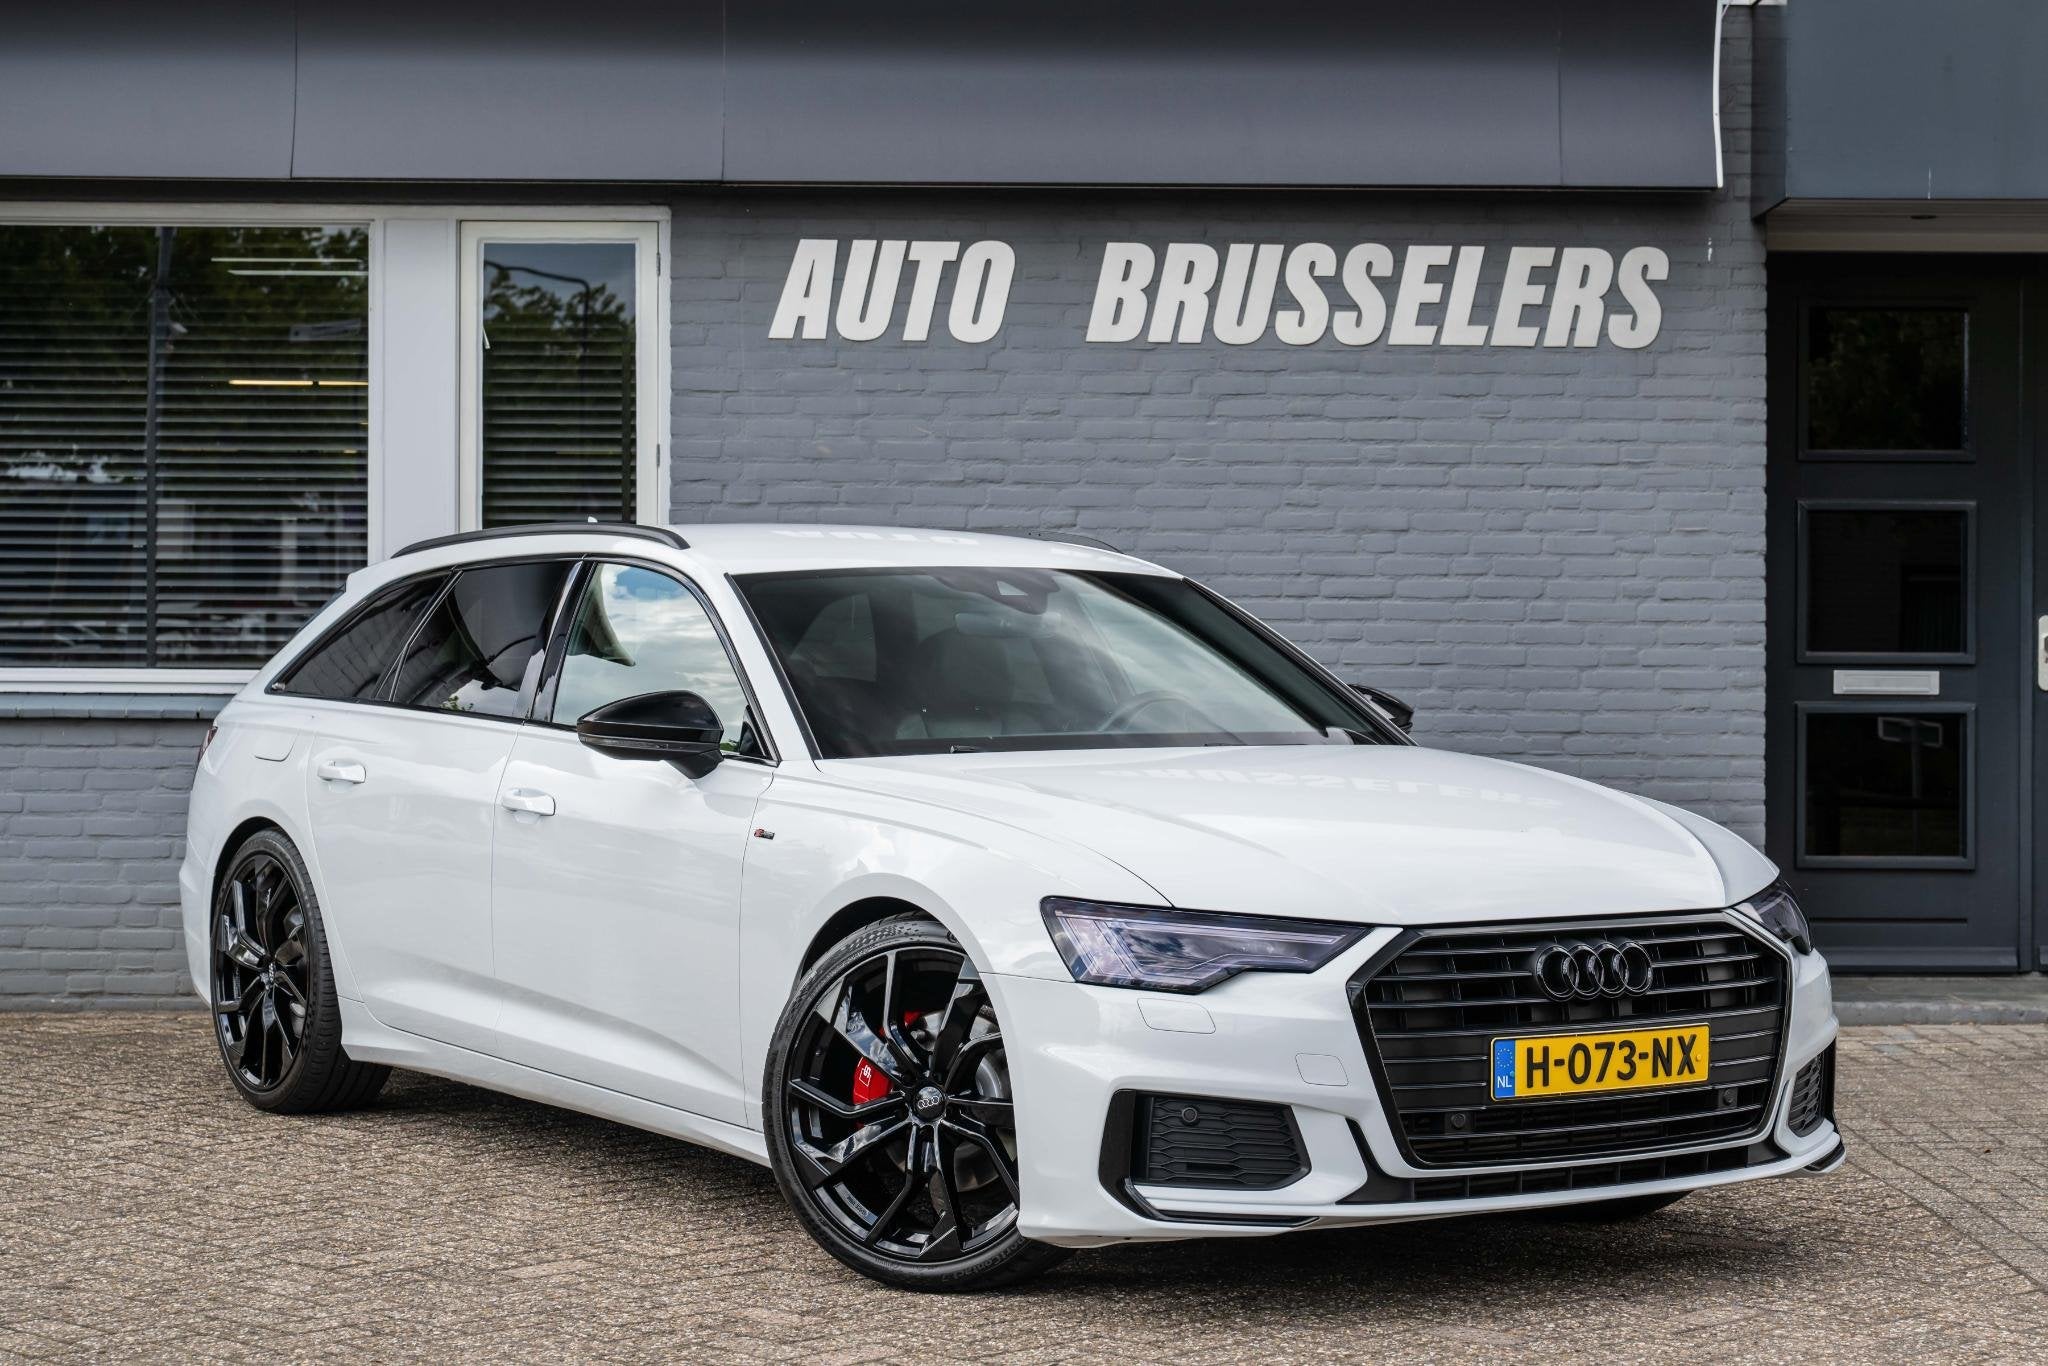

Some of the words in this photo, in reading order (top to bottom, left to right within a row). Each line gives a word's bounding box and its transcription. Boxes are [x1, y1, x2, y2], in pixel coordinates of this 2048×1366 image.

[768, 239, 1016, 343] AUTO
[1086, 242, 1670, 349] BRUSSELERS
[1497, 1075, 1512, 1088] NL
[1526, 1034, 1697, 1088] H-073-NX
